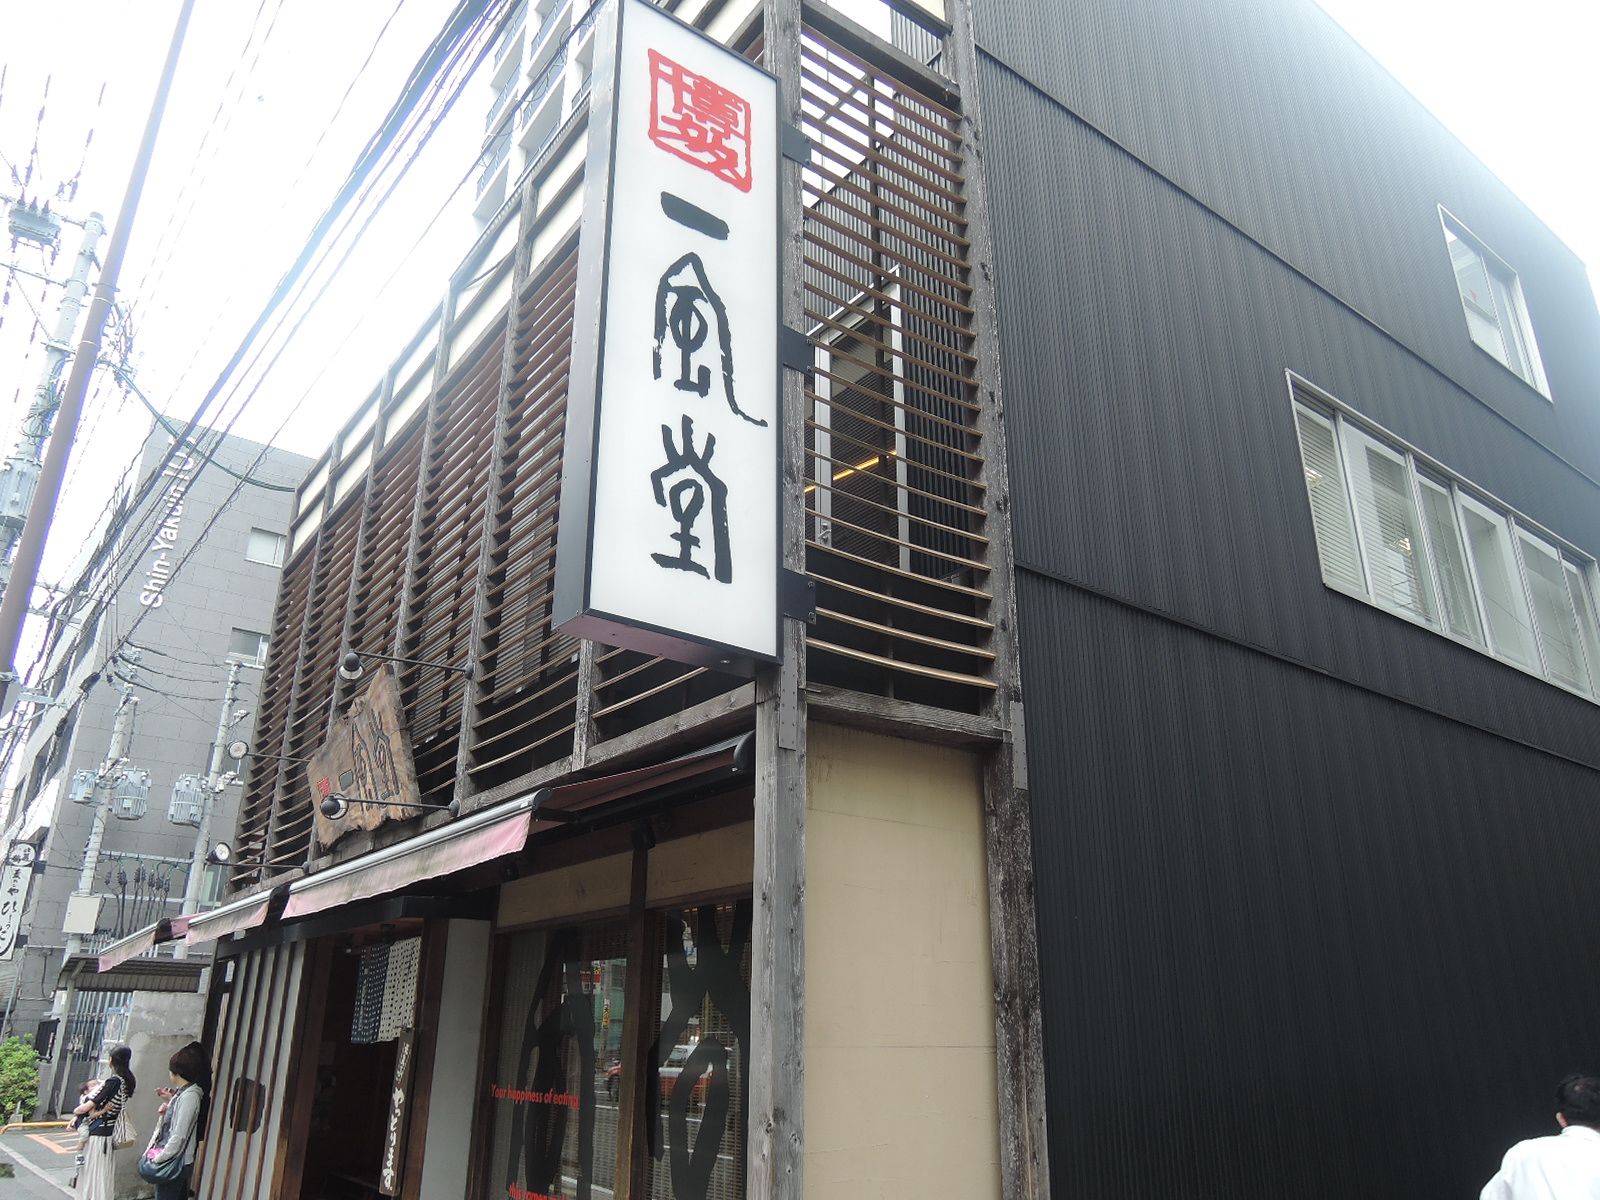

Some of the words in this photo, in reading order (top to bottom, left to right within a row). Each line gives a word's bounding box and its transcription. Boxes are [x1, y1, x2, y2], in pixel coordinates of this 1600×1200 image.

[651, 190, 767, 585] 一風堂
[507, 1084, 543, 1104] happiness
[544, 1087, 554, 1104] of
